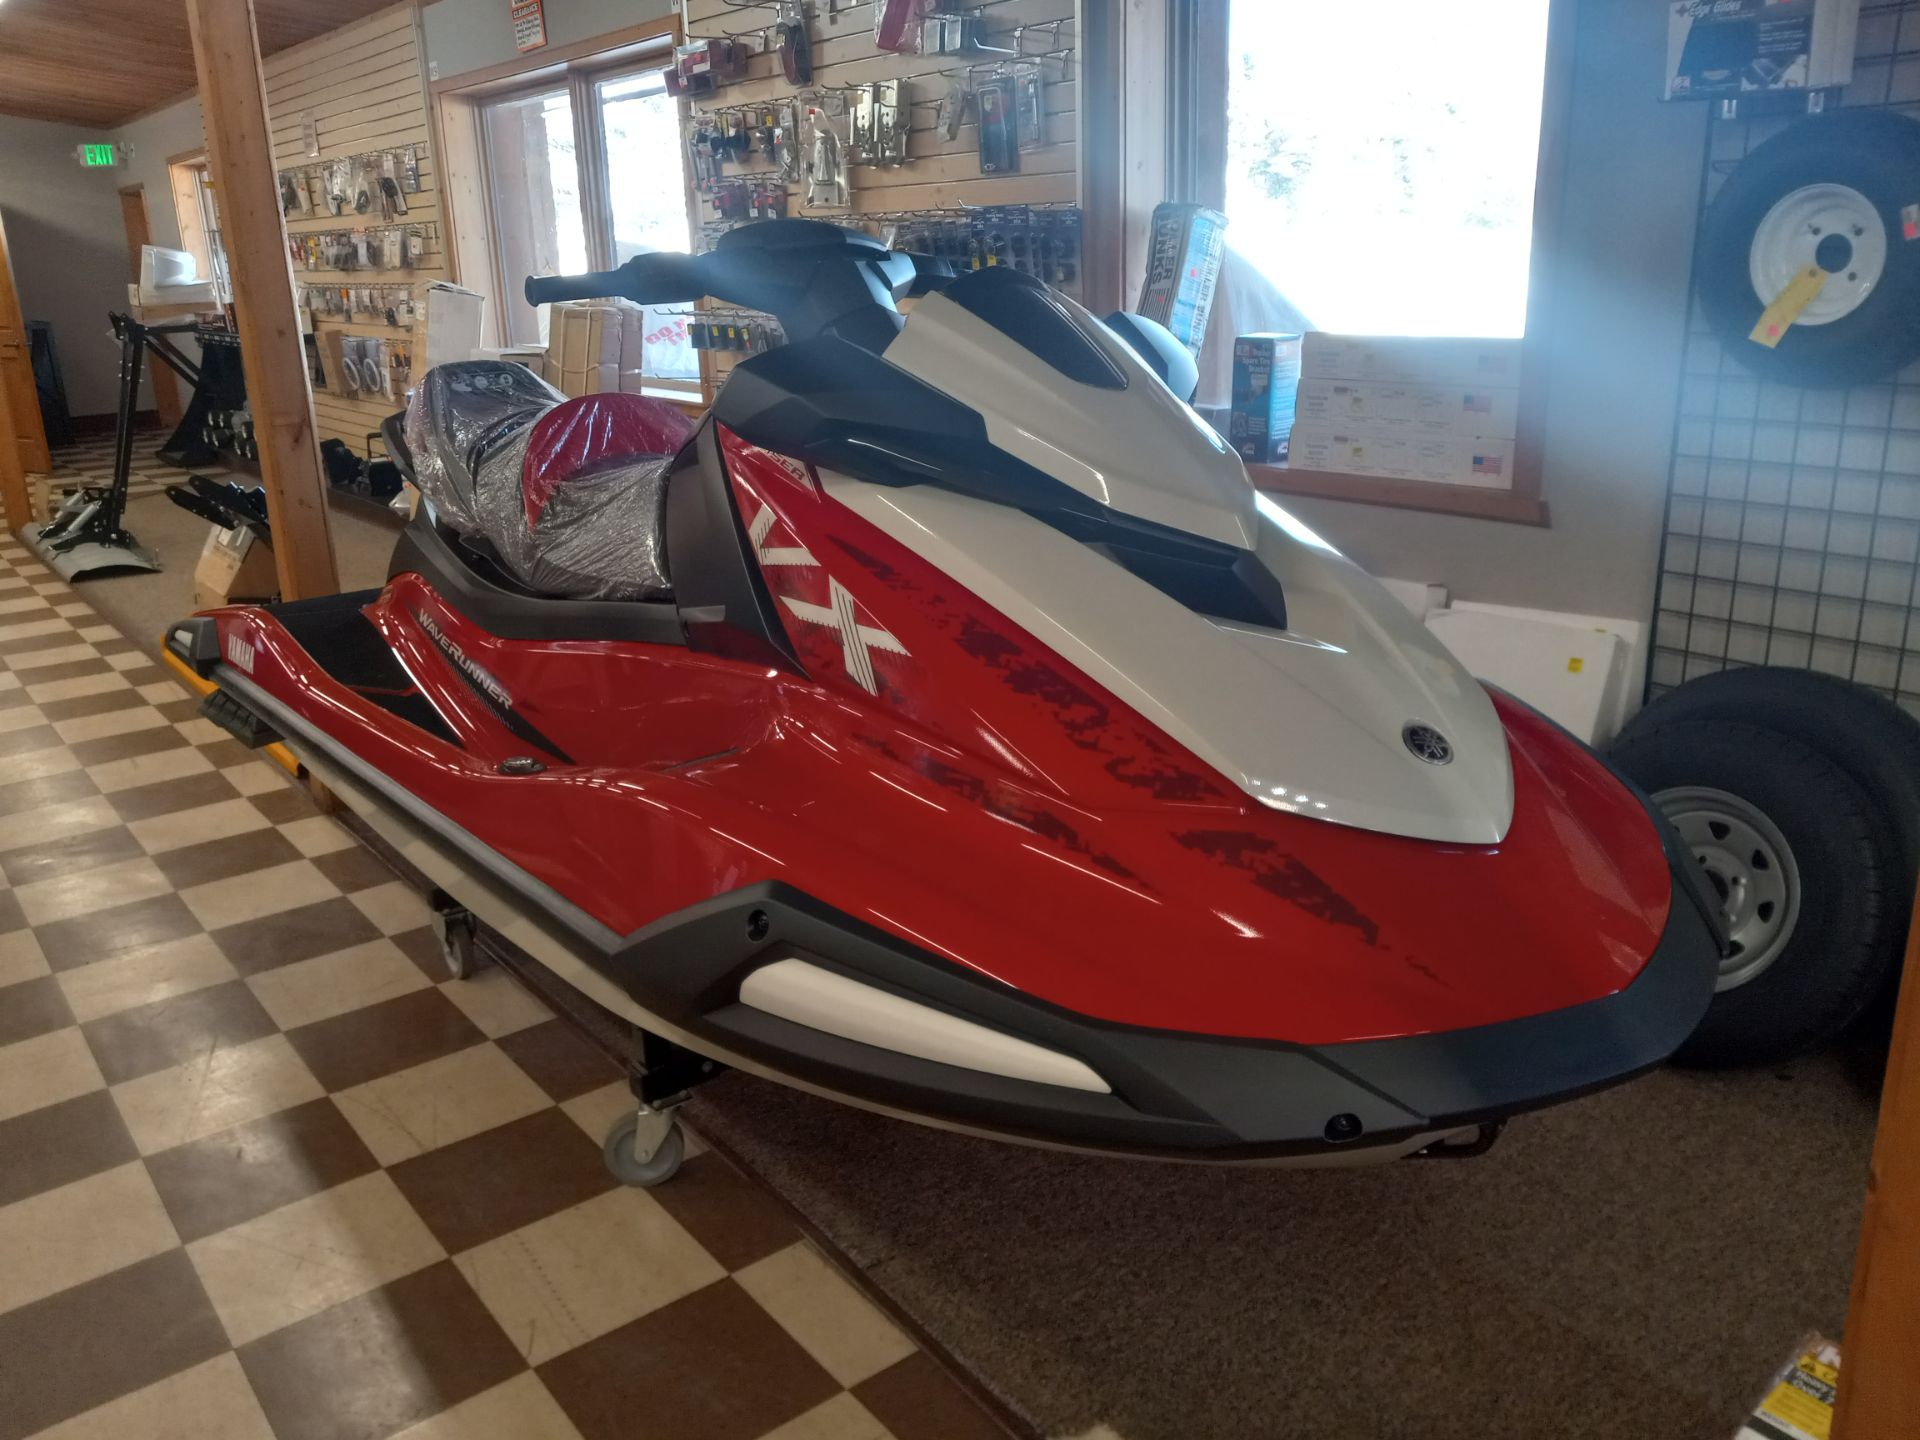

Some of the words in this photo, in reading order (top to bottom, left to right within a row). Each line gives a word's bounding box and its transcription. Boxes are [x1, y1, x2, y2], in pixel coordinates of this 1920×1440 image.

[1688, 1, 1713, 18] Edge
[1713, 0, 1742, 13] Glides
[85, 144, 113, 166] EXIT
[228, 633, 255, 675] YAMAHA
[419, 608, 513, 710] WAVERUNNER
